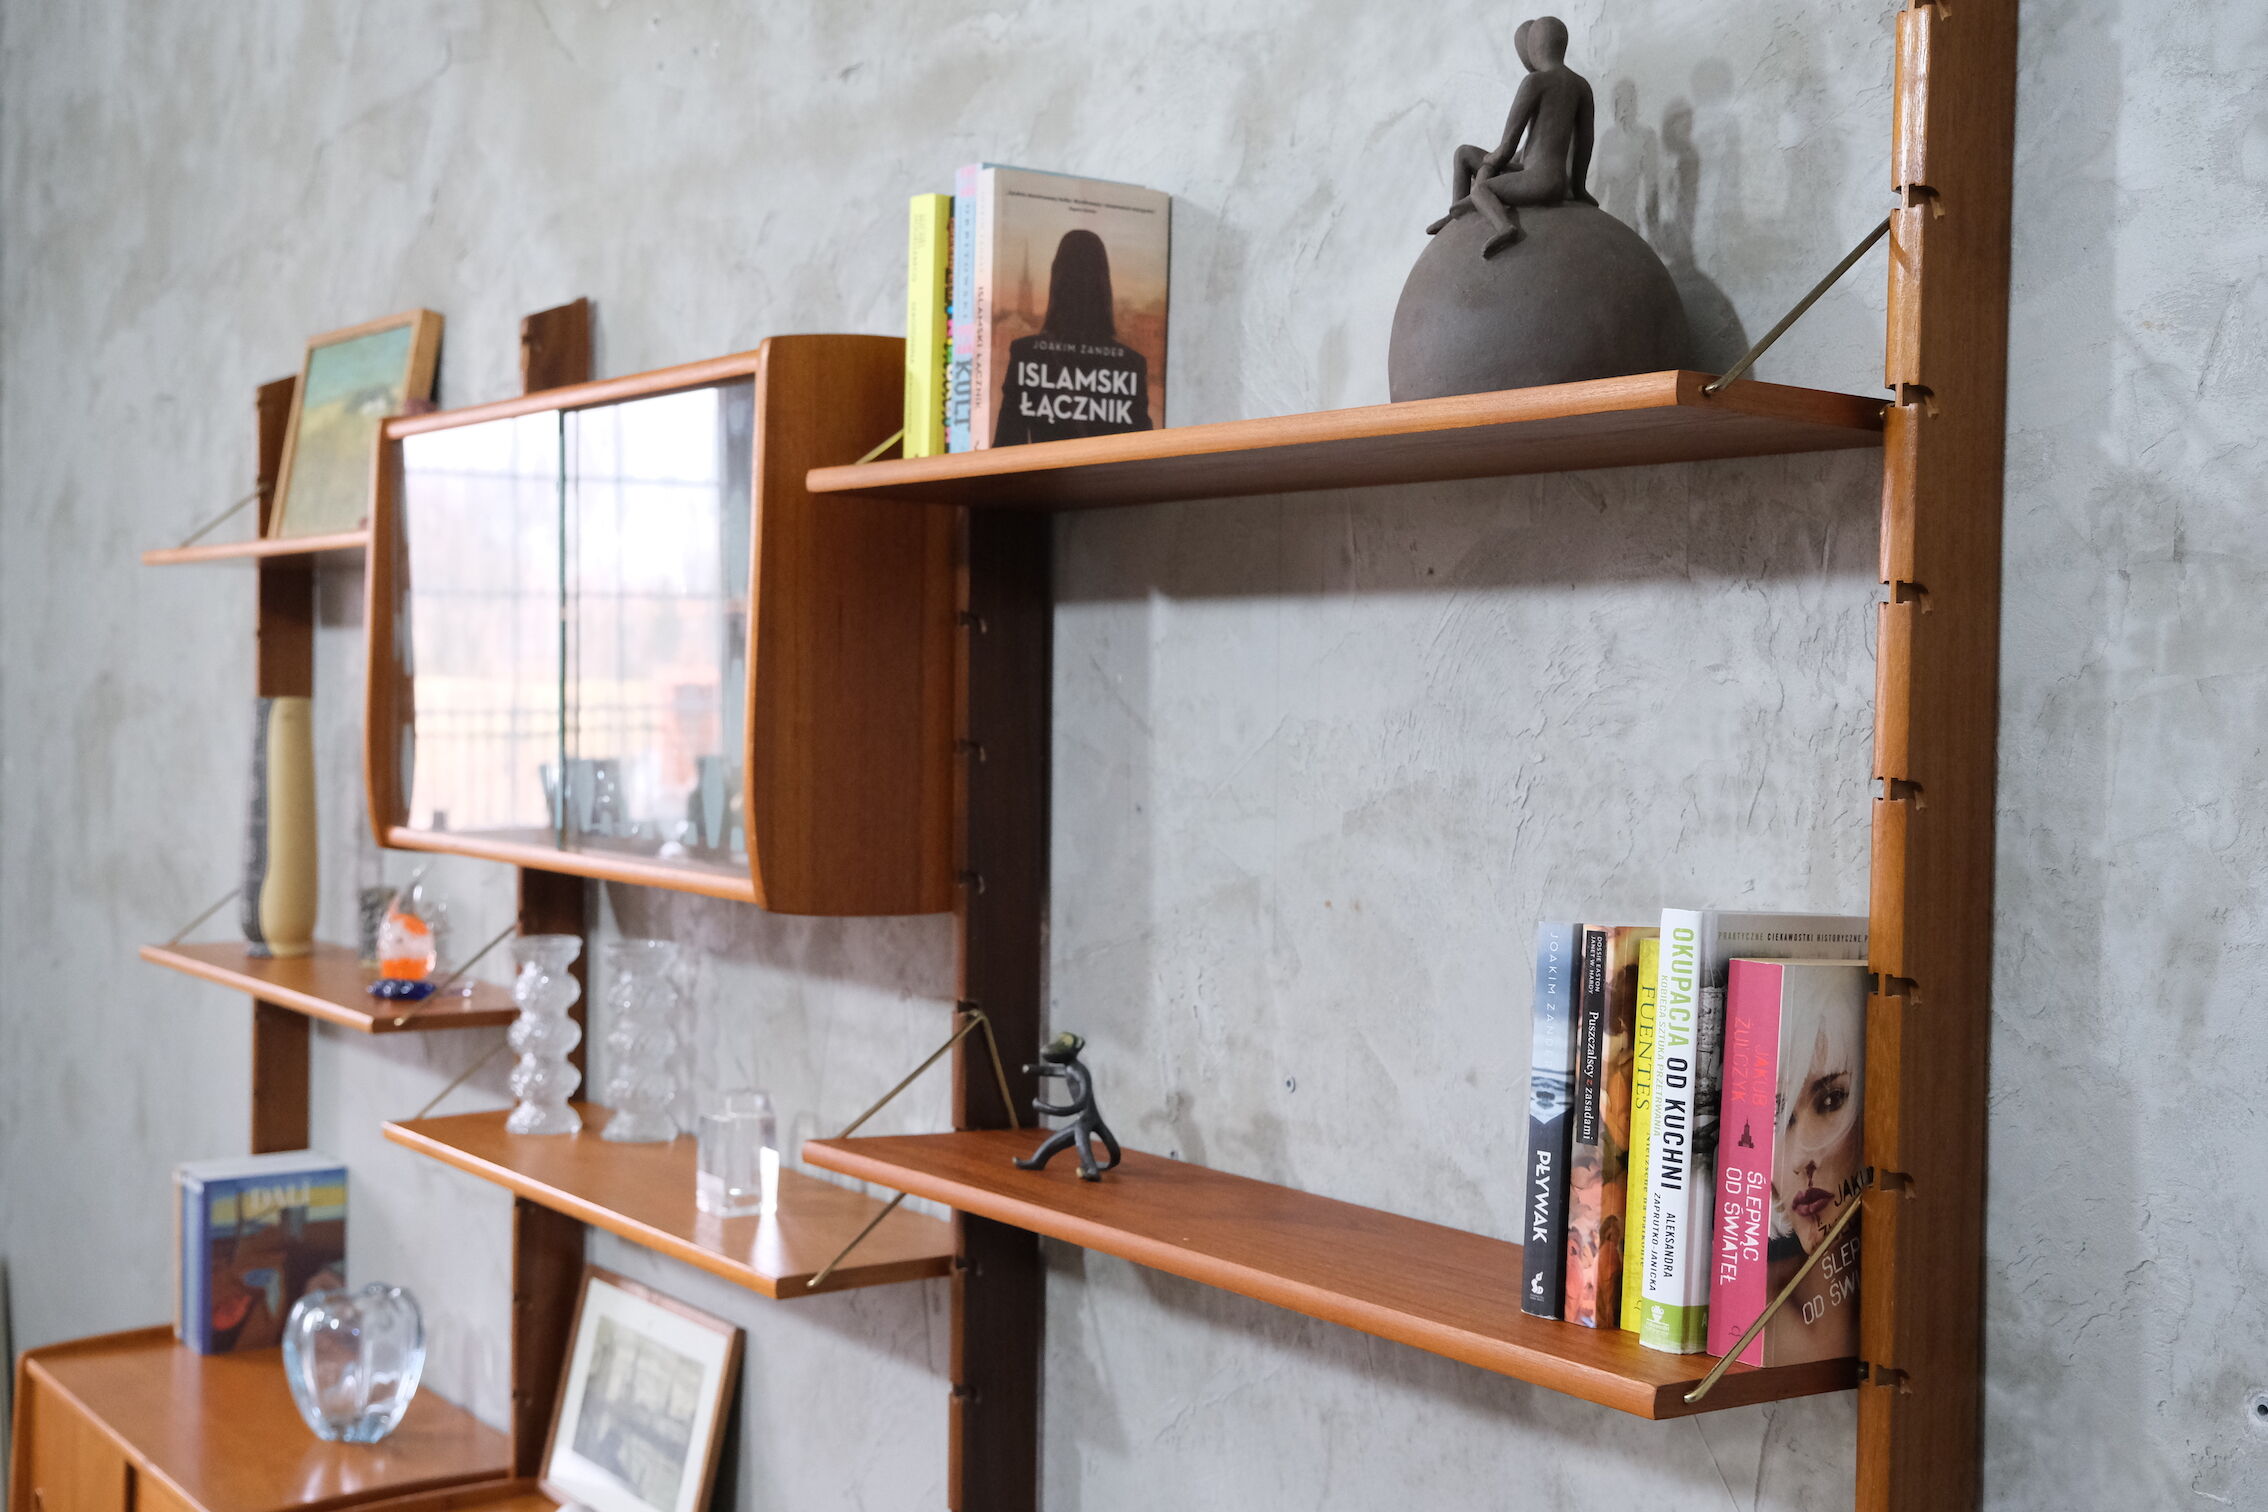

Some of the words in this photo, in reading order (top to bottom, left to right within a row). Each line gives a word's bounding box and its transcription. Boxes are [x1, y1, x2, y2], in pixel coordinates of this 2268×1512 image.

[975, 285, 984, 348] ISLAMSKI
[1018, 361, 1138, 397] ISLAMSKI
[1033, 340, 1077, 353] JOAKIM
[1080, 343, 1125, 358] ZANDER
[954, 357, 973, 432] KULT
[1019, 390, 1133, 425] ŁĄCZNIK
[1547, 932, 1559, 994] JOAKIM
[1595, 936, 1603, 961] DOSSIE
[1718, 931, 1764, 941] PRAKTYCZNE
[1767, 932, 1814, 942] CIEKAWOSTKI
[1594, 963, 1602, 993] EASTON
[1658, 975, 1668, 1018] KOBIECA
[1667, 927, 1695, 1047] OKUPACJA
[1583, 1011, 1599, 1078] Puszczalscy
[1636, 985, 1656, 1110] FUENTES
[1657, 1021, 1666, 1061] SZTUKA
[1653, 1063, 1664, 1137] PRZETRWANIA
[1666, 1057, 1688, 1089] OD
[1752, 1043, 1770, 1108] JAKUB
[1583, 1087, 1595, 1140] zasadami
[1660, 1098, 1686, 1190] KUCHNI
[1532, 1149, 1552, 1243] PŁYWAK
[1725, 1166, 1743, 1195] OD
[1649, 1192, 1662, 1292] ZAPRUTKO-JANICKA
[1663, 1212, 1676, 1279] ALEKSANDRA
[1719, 1202, 1744, 1286] ŚWIATEŁ
[1740, 1171, 1767, 1262] ŚLEPNĄC
[1801, 1294, 1825, 1326] OD
